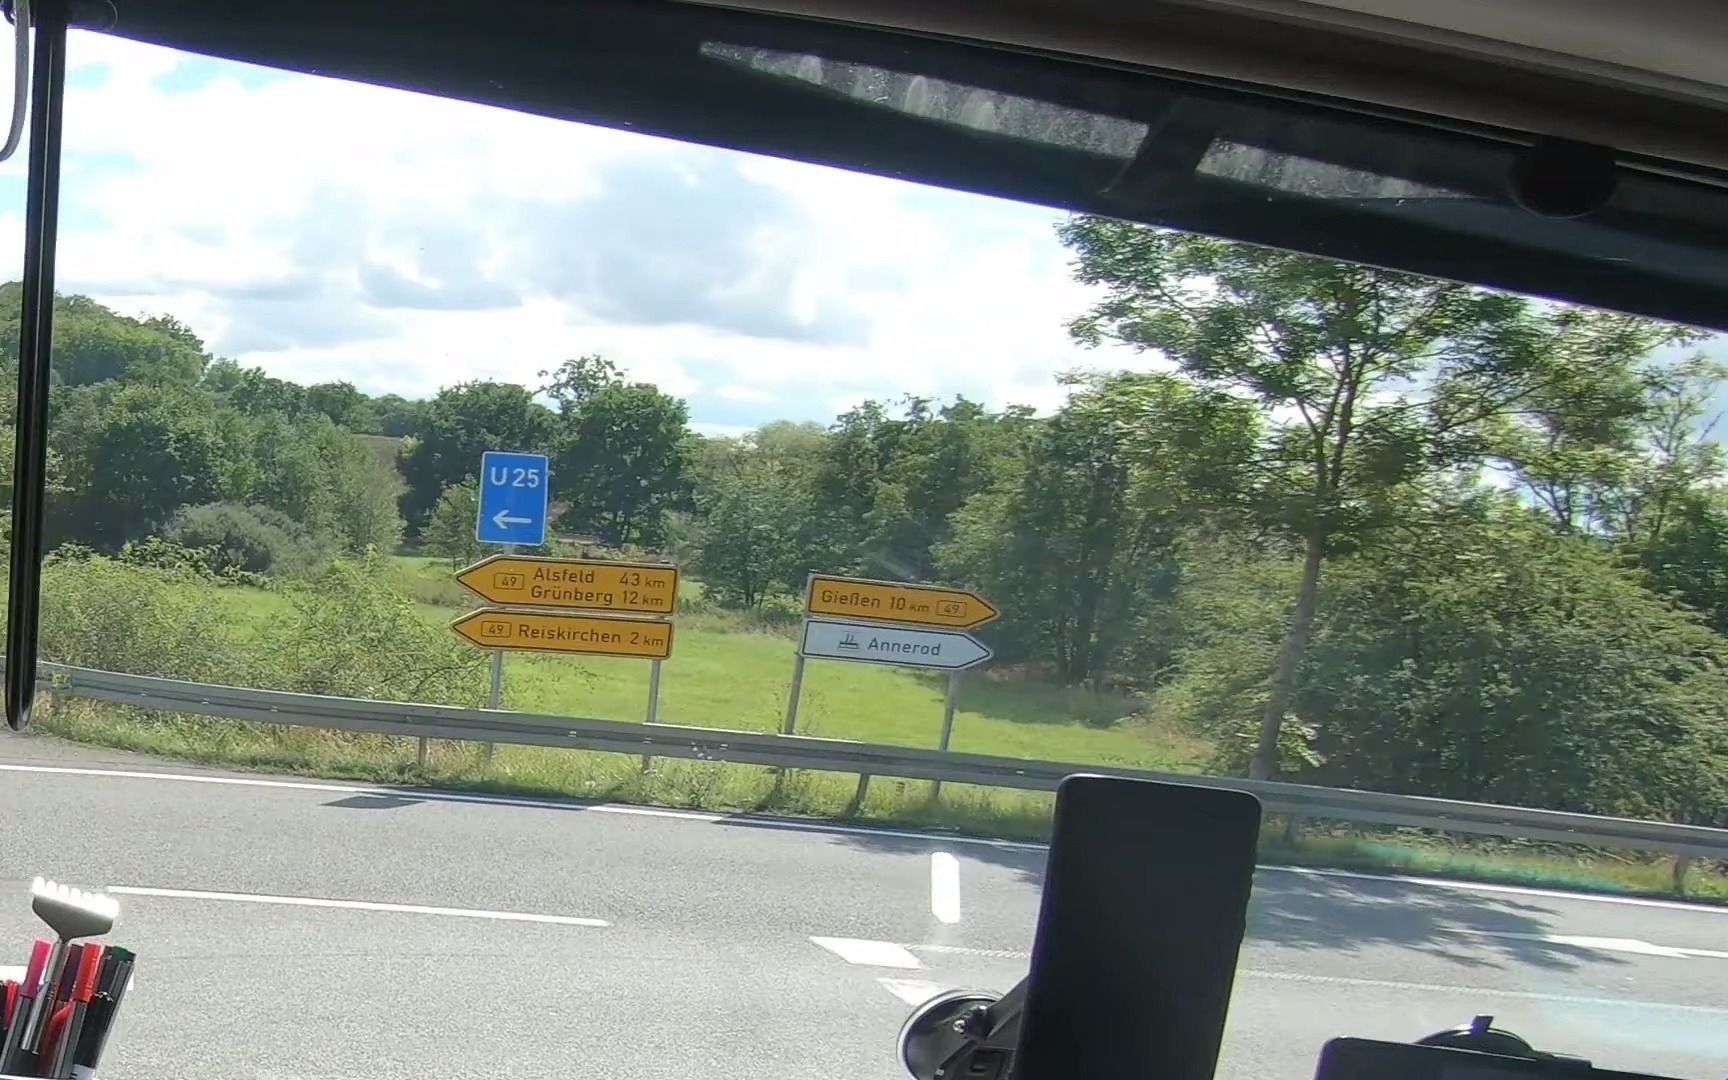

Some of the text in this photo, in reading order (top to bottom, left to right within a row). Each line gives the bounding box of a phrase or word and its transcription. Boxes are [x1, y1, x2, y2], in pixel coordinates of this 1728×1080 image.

[490, 466, 540, 488] U 25
[501, 576, 517, 587] 49
[533, 567, 665, 589] Alsfeld 43 km
[530, 585, 664, 607] Grünberg 12 km
[821, 589, 960, 614] Gießen 10 km 49
[488, 623, 664, 647] 49 Reiskirchen 2 km
[867, 637, 941, 656] Annerod
